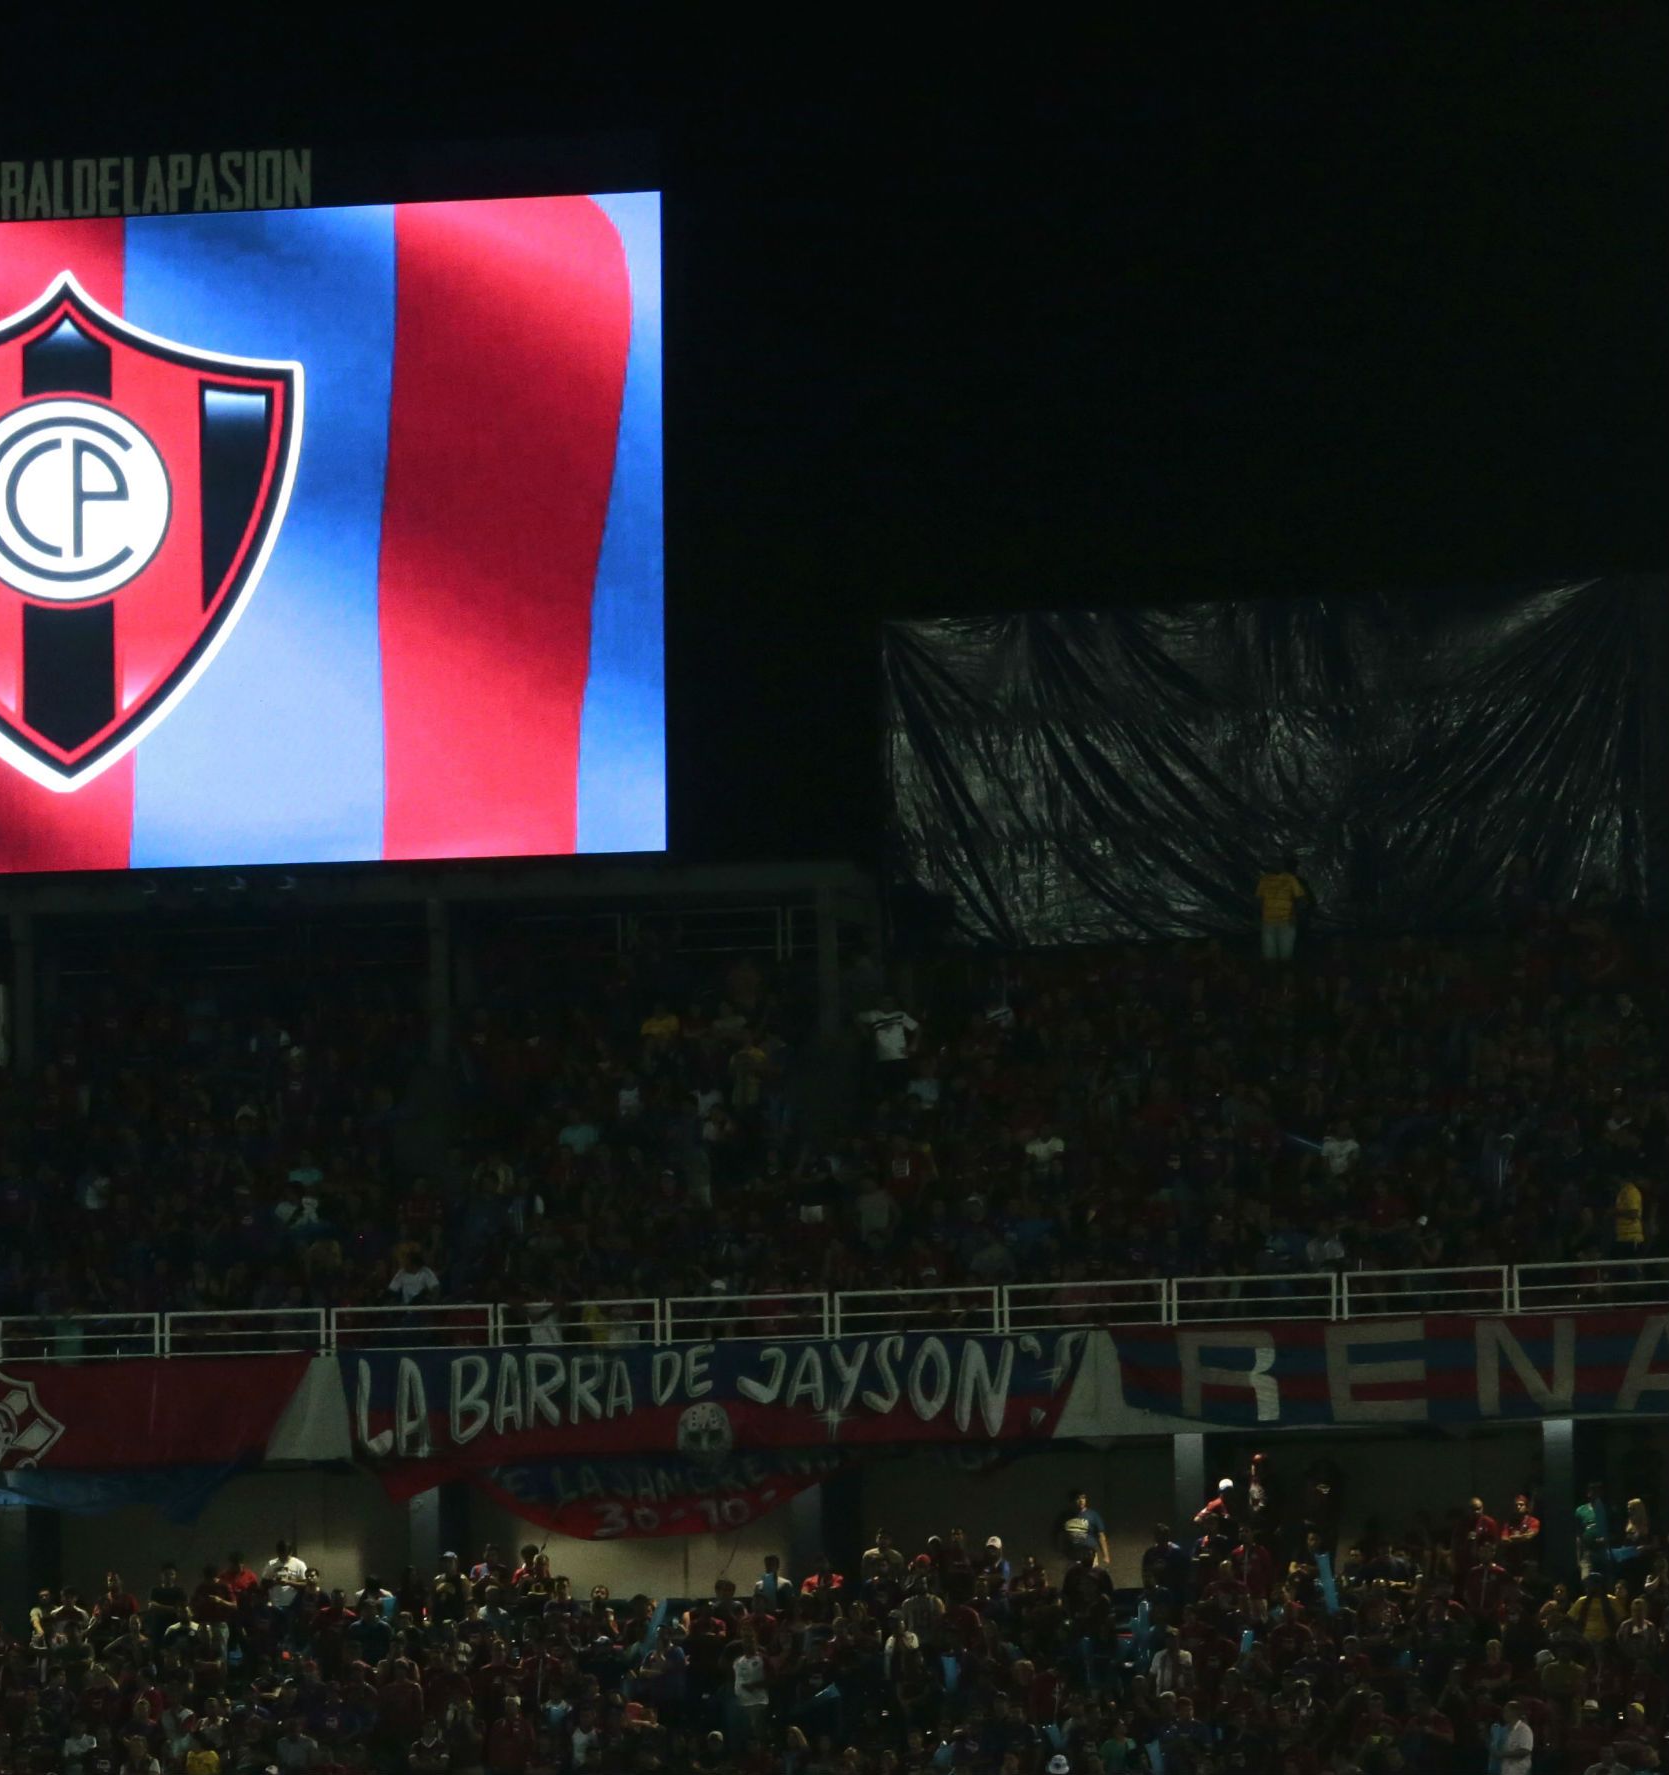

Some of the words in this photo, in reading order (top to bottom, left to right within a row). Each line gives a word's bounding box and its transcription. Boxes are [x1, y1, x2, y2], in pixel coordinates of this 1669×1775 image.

[356, 1357, 431, 1457] LA
[449, 1351, 633, 1446] BARRA
[651, 1343, 715, 1407] DE
